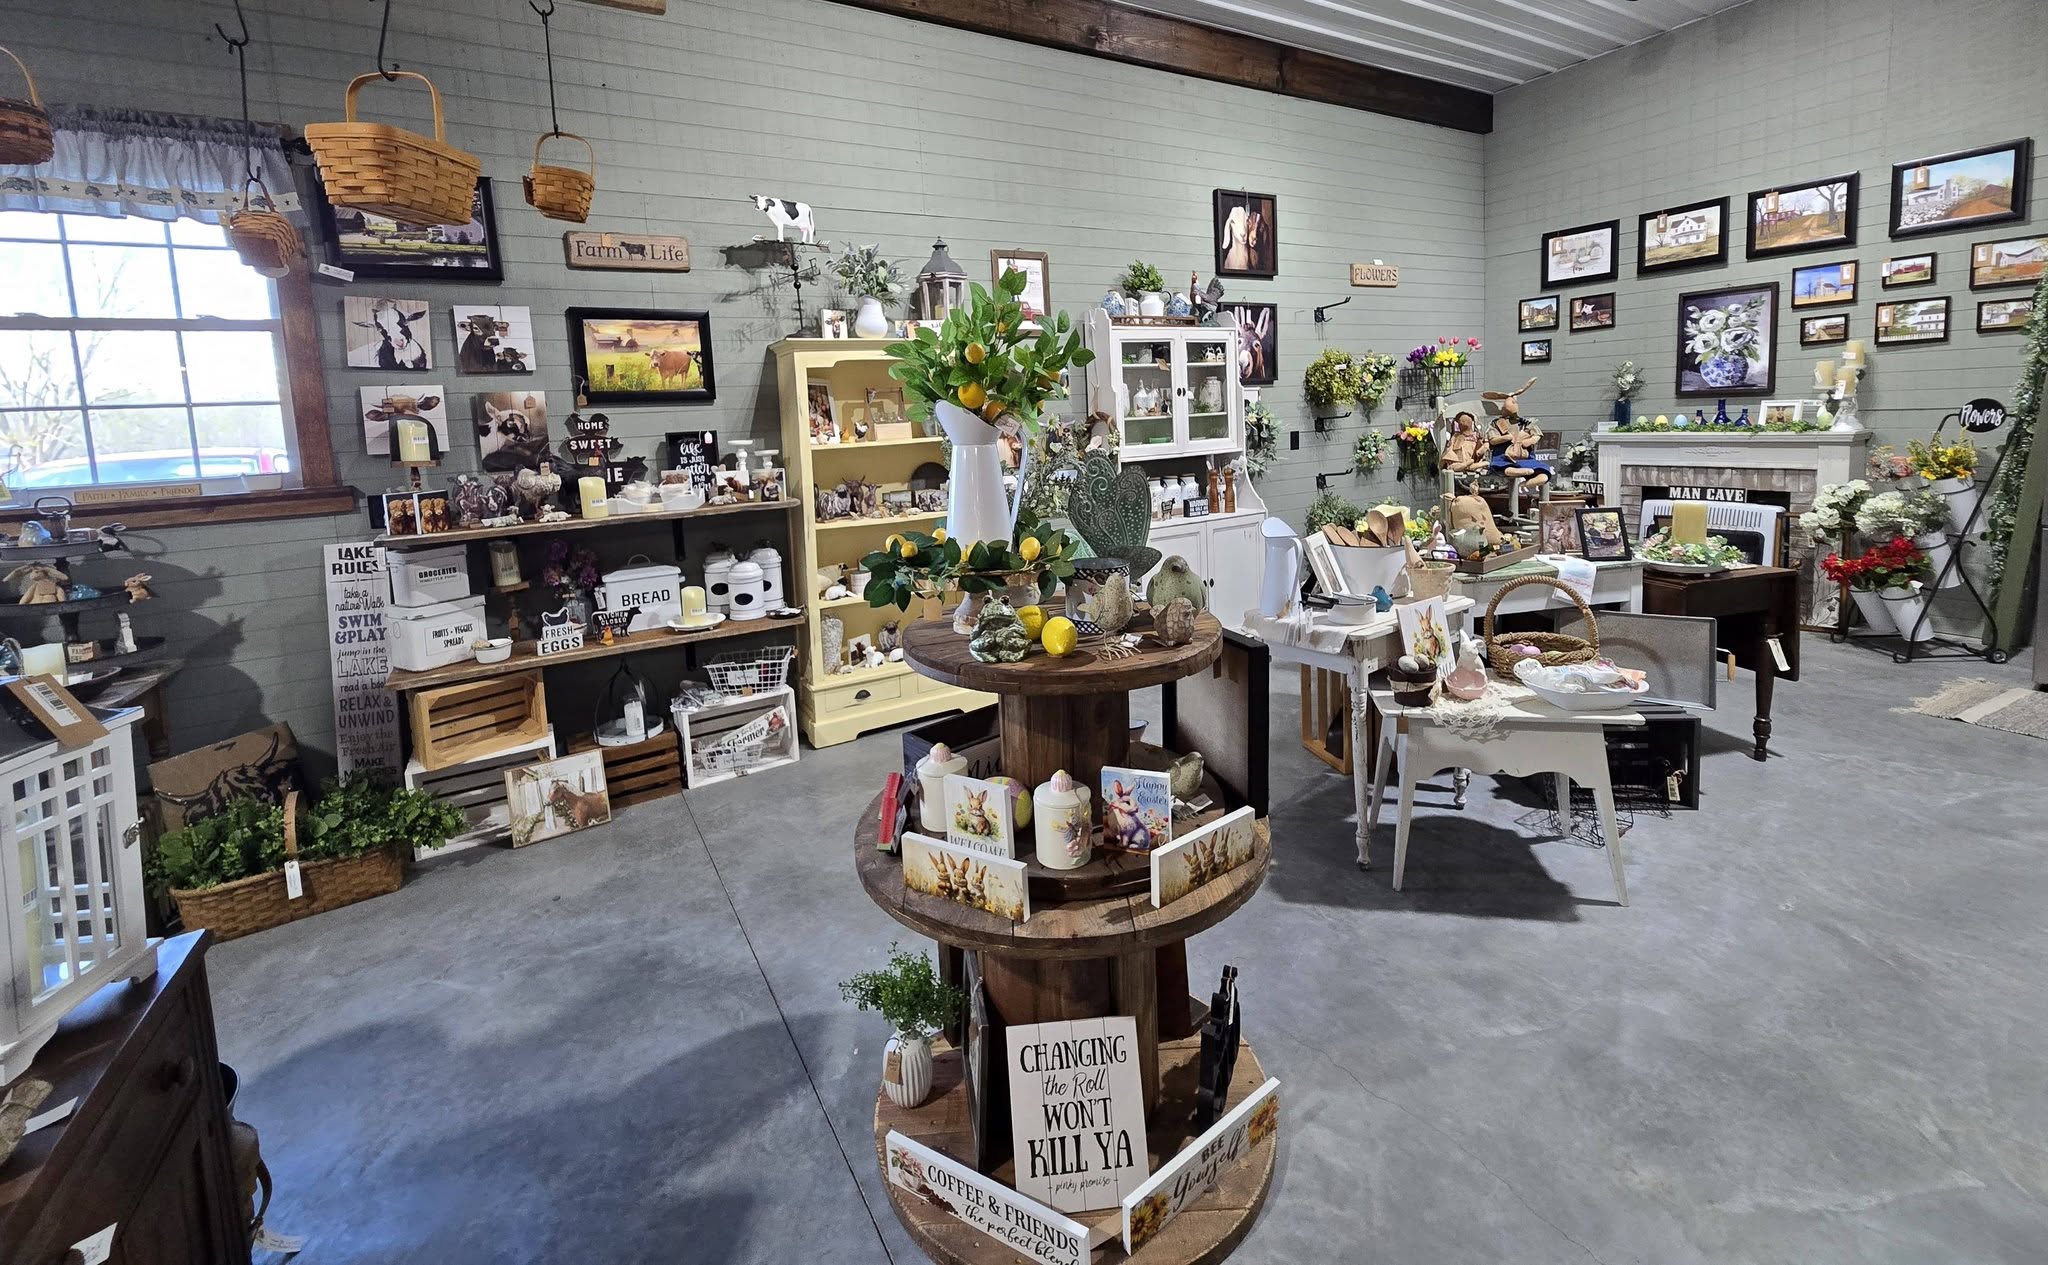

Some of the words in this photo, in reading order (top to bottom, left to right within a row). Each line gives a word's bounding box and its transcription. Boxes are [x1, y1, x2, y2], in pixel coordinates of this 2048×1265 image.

[576, 240, 623, 259] Farm
[650, 244, 684, 261] Life
[1354, 267, 1397, 282] FLOWERS
[1961, 404, 2005, 427] Flowers
[577, 421, 604, 430] HOME
[680, 442, 702, 456] life
[81, 493, 107, 501] FAITH
[119, 490, 150, 499] FAMILY
[161, 486, 196, 497] FRIENDS
[1584, 483, 1603, 495] AVE
[1669, 486, 1701, 500] MAN
[1706, 488, 1744, 502] CAVE
[338, 546, 375, 560] LAKE
[418, 566, 458, 579] GROCERIES
[344, 587, 359, 599] take
[621, 589, 670, 607] BREAD
[338, 613, 382, 629] SWIM
[598, 612, 629, 622] KITCHEN
[432, 627, 449, 640] FRUITS
[455, 624, 473, 635] VEGGIES
[545, 625, 574, 639] FRESH
[443, 636, 465, 649] SPREADS
[541, 636, 581, 655] EGGS
[337, 647, 360, 660] jump
[362, 645, 371, 655] in
[372, 645, 387, 655] the
[337, 656, 389, 678] LAKE
[340, 682, 360, 693] read
[361, 681, 368, 691] a
[339, 696, 382, 713] RELAX
[383, 696, 393, 707] &
[338, 709, 395, 729] UNWIND
[339, 731, 373, 746] Enjoy
[1134, 777, 1168, 795] Happy
[1137, 791, 1168, 806] Easter
[949, 834, 1007, 857] WELCOME
[1020, 1035, 1127, 1073] CHANGING
[1044, 1074, 1068, 1096] the
[1072, 1069, 1106, 1098] Roll
[1042, 1097, 1112, 1132] WON'T
[1027, 1133, 1089, 1179] KILL
[1094, 1129, 1134, 1171] YA
[1201, 1134, 1225, 1165] BEE
[1055, 1180, 1078, 1195] pinky
[1079, 1177, 1112, 1193] promise
[928, 1164, 985, 1208] COFFEE
[988, 1195, 1001, 1218] &
[1004, 1202, 1080, 1258] FRIENDS
[961, 1203, 986, 1226] the
[987, 1220, 1037, 1252] perfect
